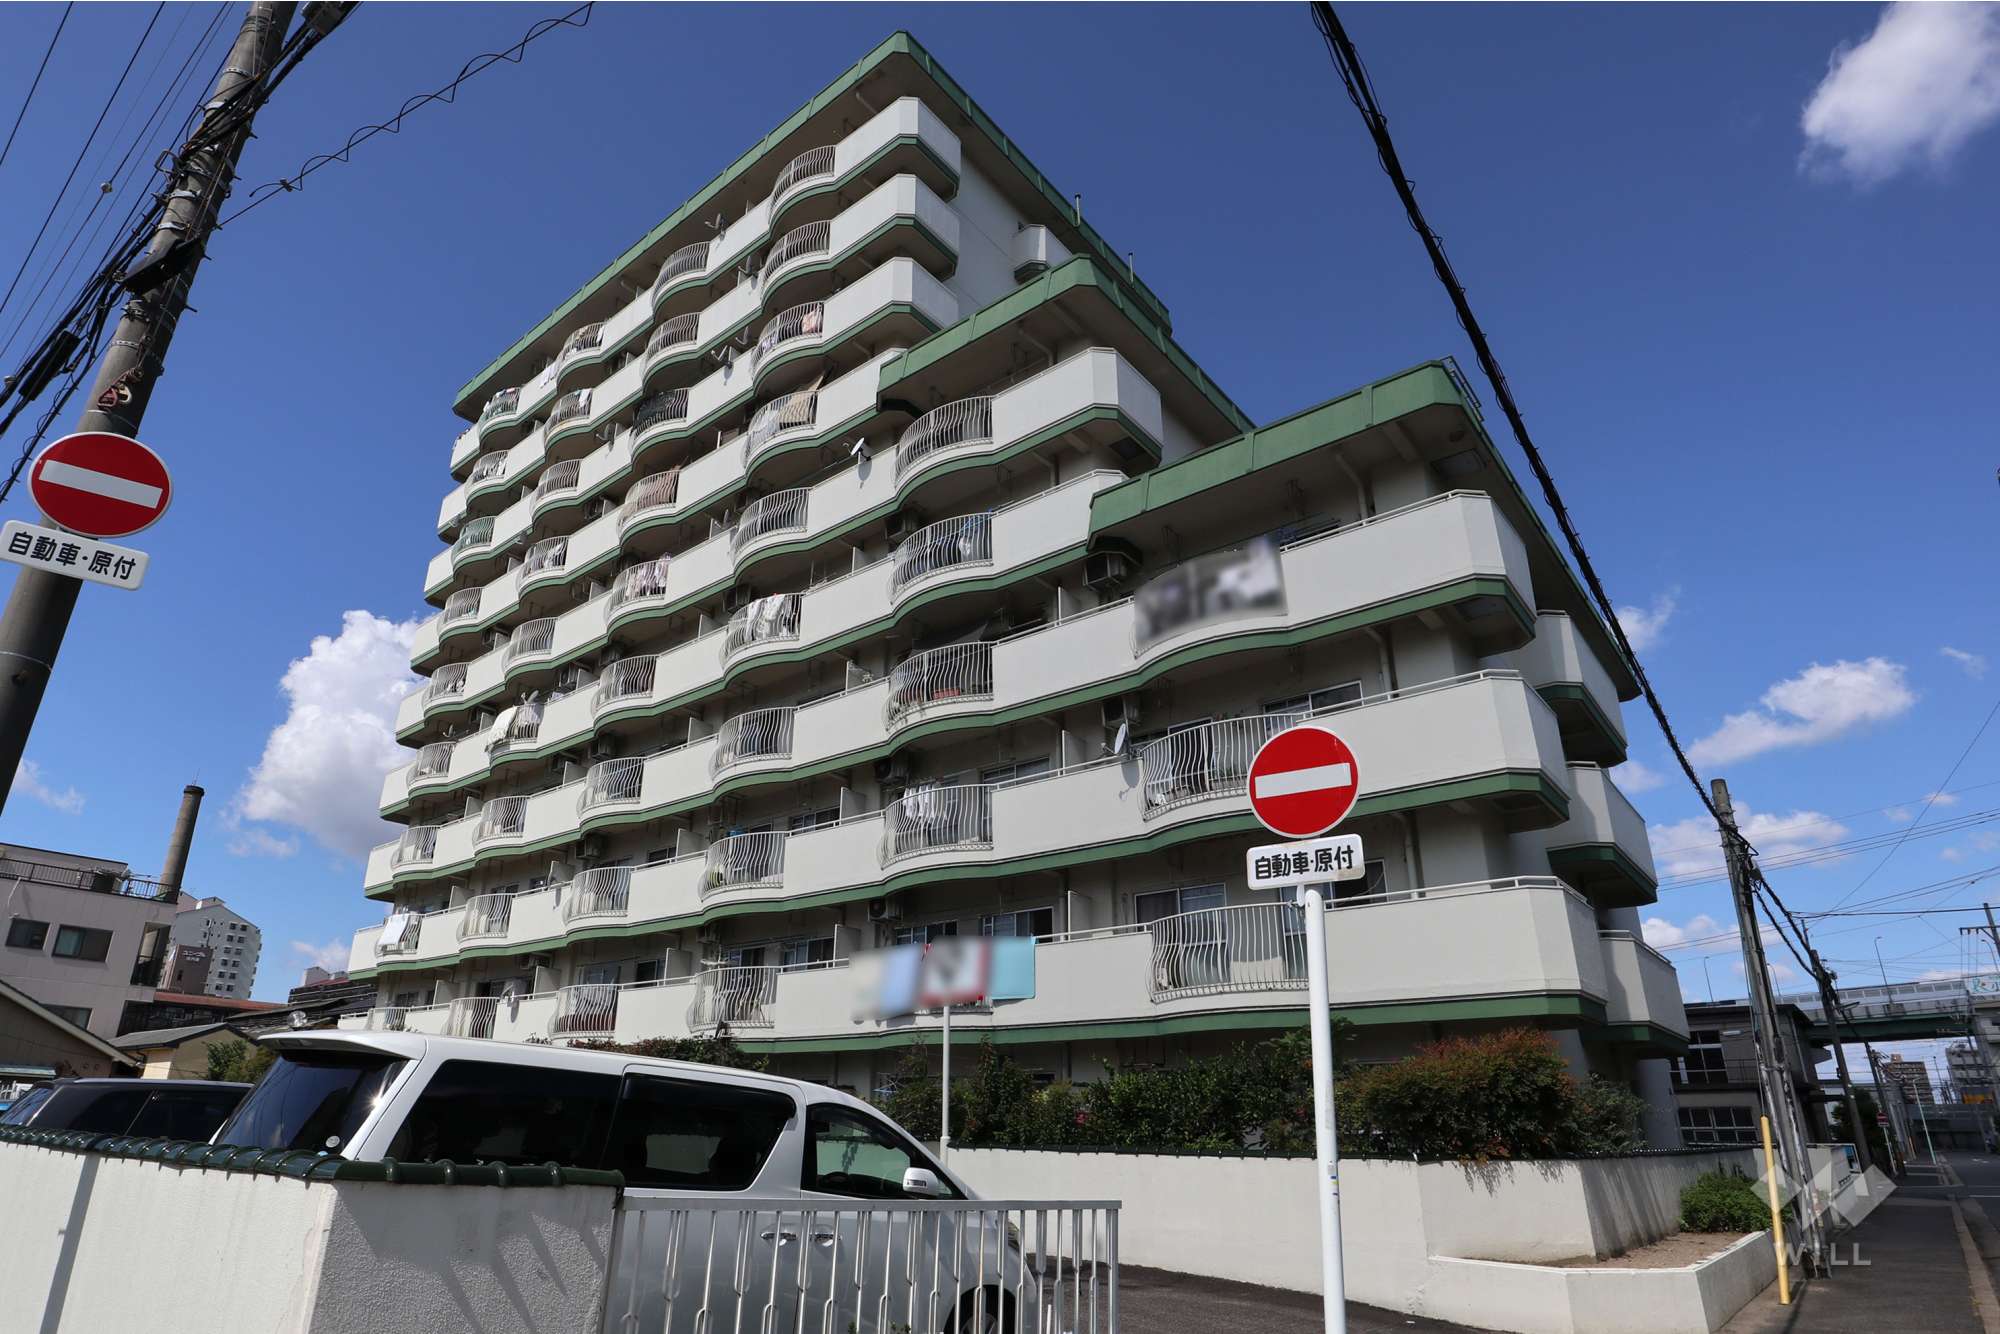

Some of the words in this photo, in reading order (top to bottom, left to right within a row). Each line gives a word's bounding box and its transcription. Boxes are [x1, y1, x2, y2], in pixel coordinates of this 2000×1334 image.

[8, 531, 137, 580] 自動車・原付
[1254, 844, 1355, 880] 自動車・原付
